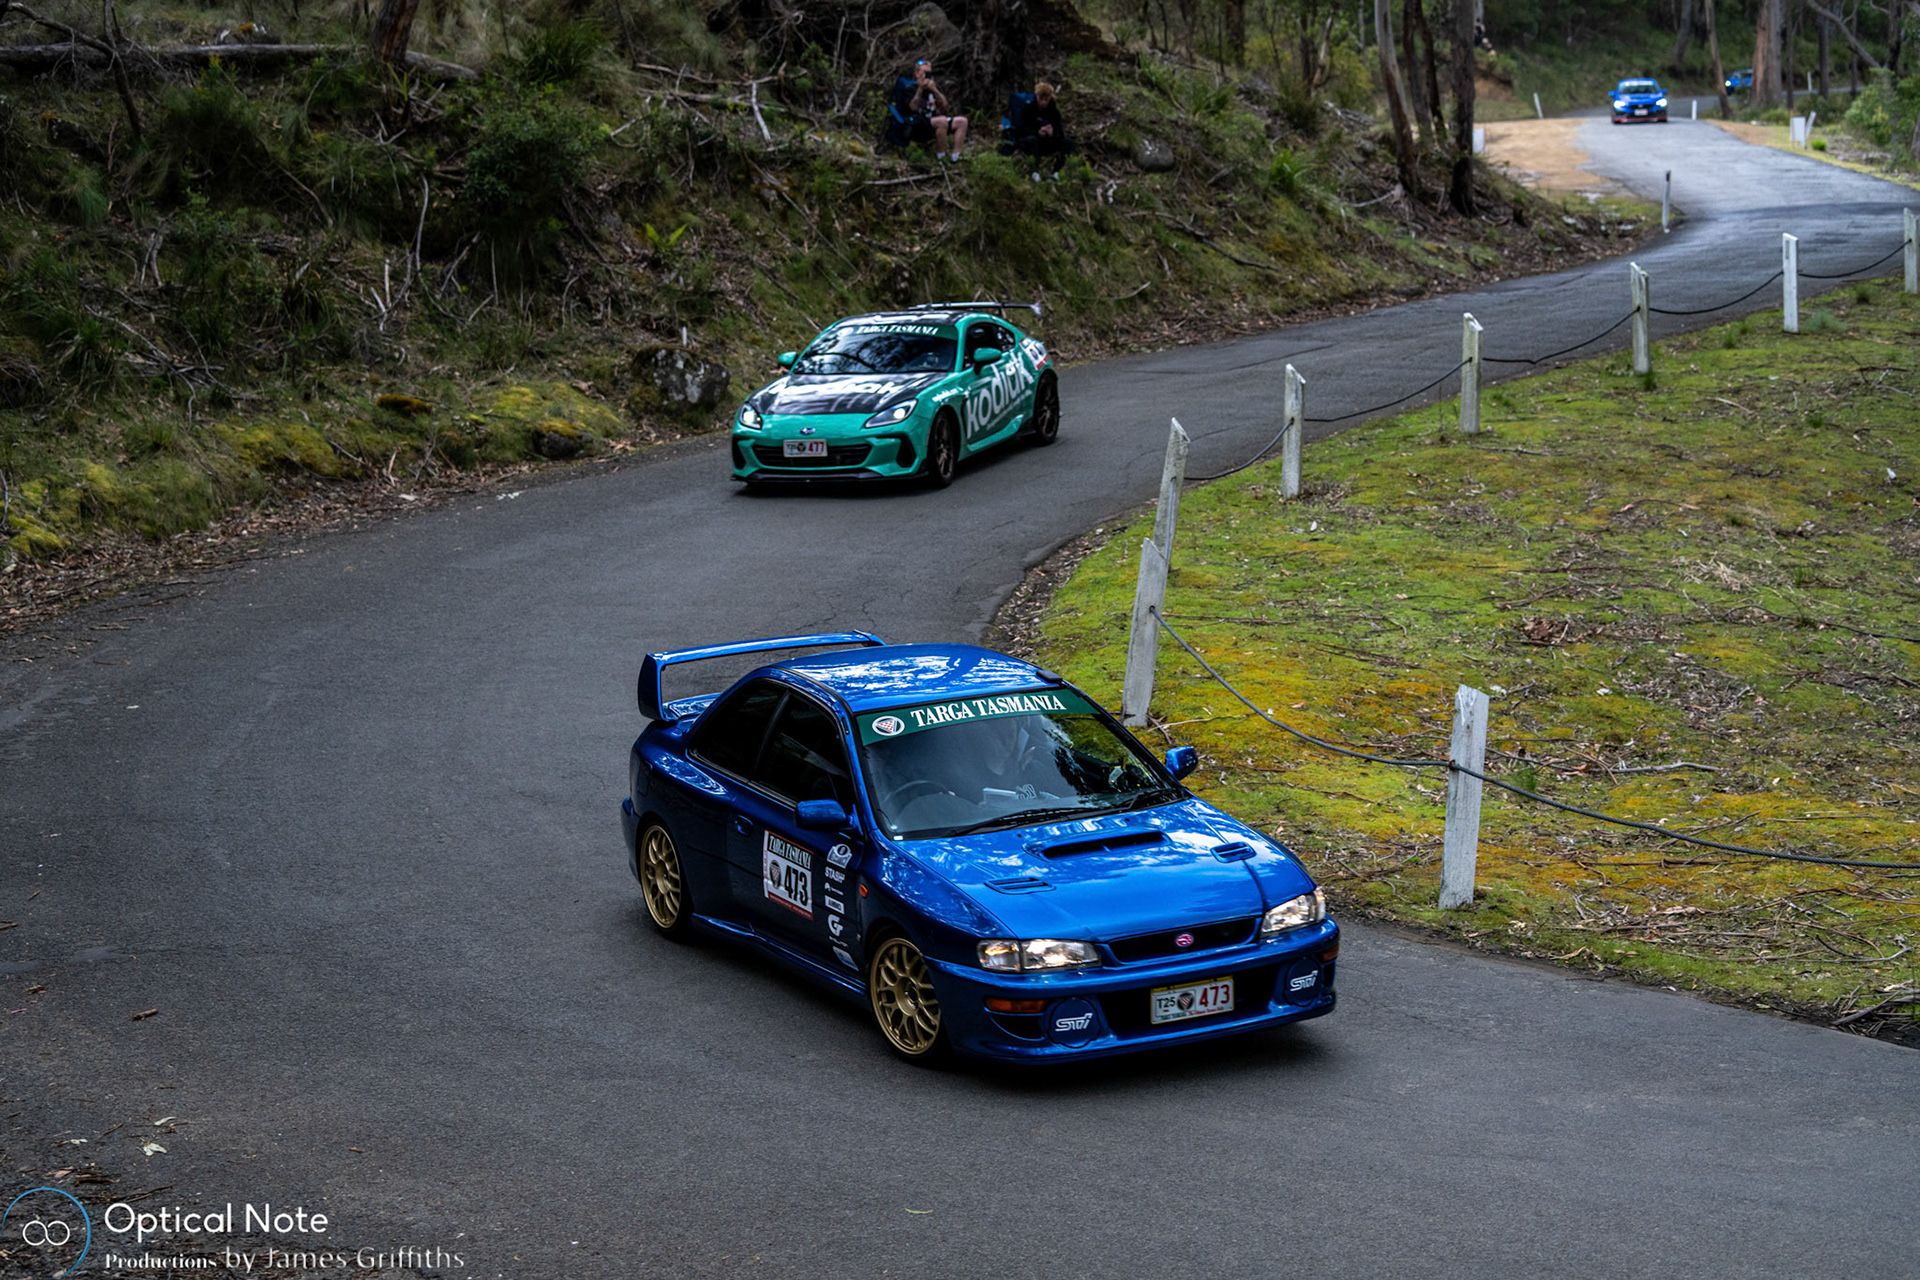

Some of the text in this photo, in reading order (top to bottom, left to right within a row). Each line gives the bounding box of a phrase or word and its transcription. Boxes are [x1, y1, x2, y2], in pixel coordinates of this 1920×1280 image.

[808, 441, 825, 452] 477
[910, 695, 1067, 728] TARGA TASMANIA
[784, 865, 808, 907] 473
[1156, 984, 1230, 1009] T25 473
